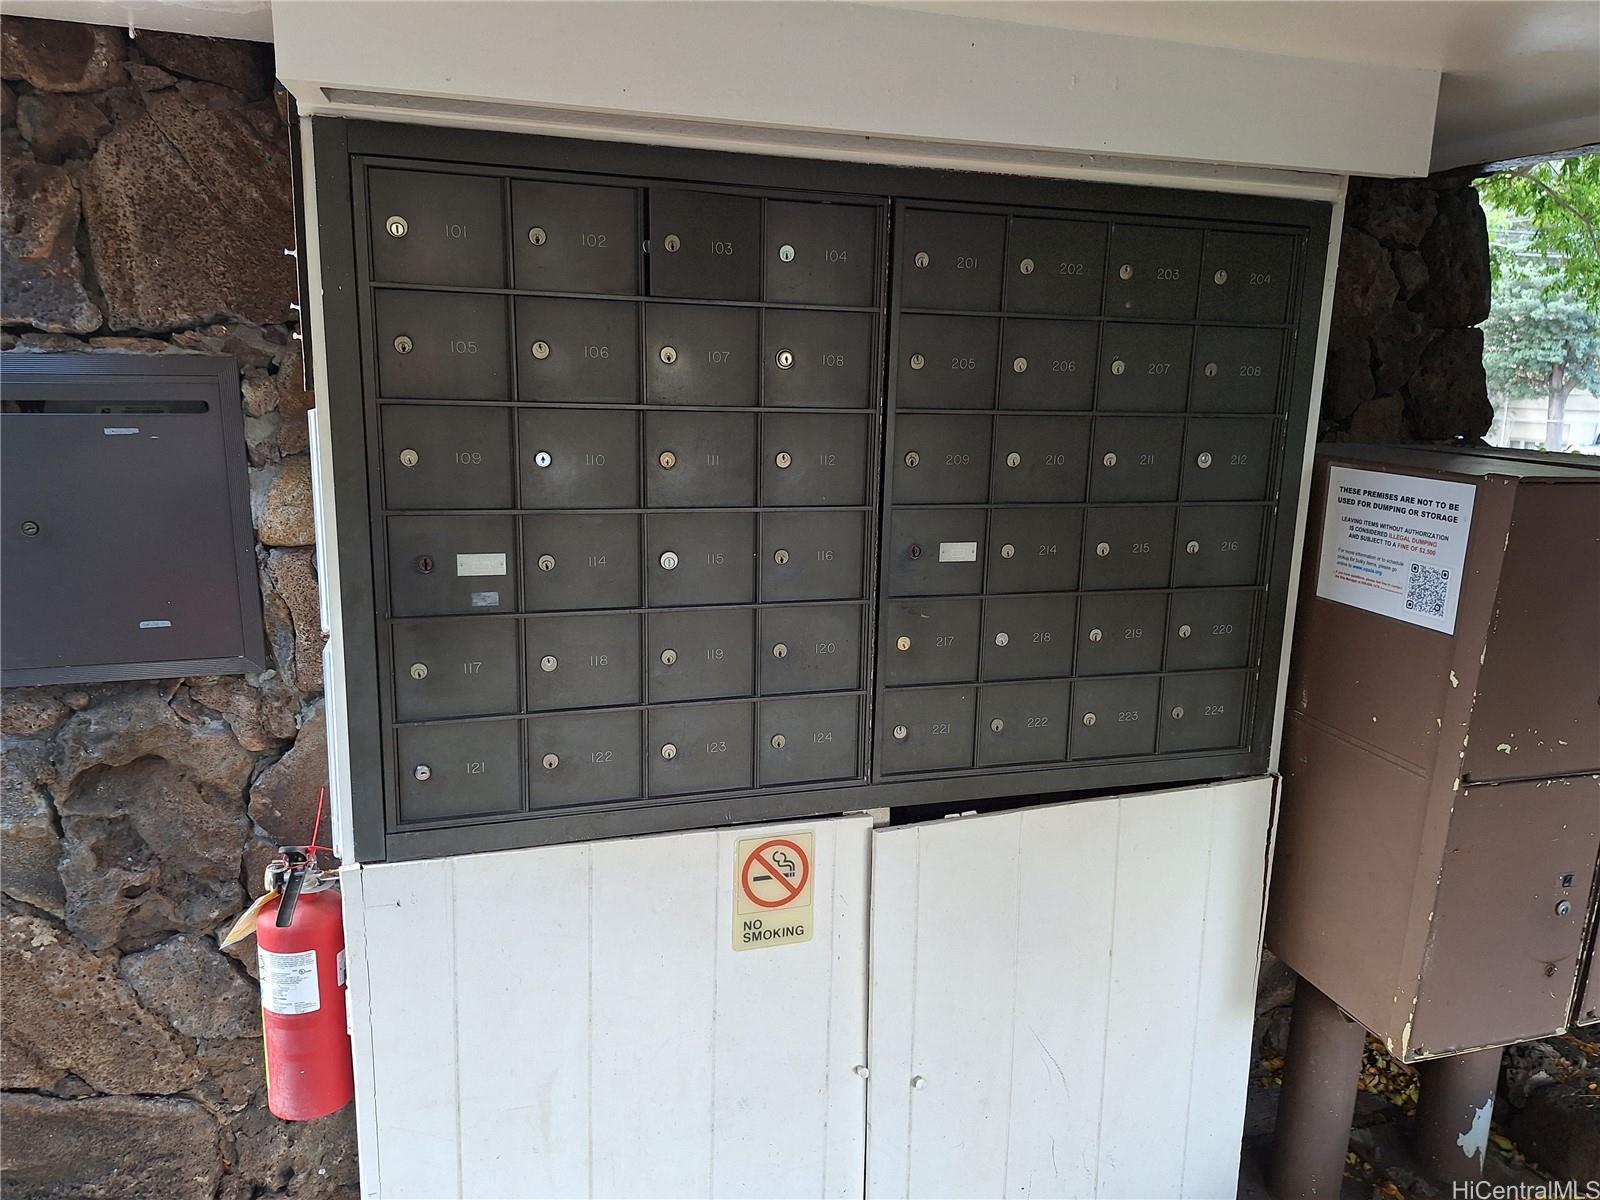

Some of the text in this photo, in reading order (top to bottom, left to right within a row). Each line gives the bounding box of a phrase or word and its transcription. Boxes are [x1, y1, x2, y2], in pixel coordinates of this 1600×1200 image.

[445, 224, 467, 239] 101
[581, 233, 607, 249] 102
[711, 242, 732, 256] 103
[824, 250, 848, 263] 104
[956, 257, 978, 269] 201
[1060, 264, 1083, 275] 202
[1157, 268, 1180, 280] 203
[1249, 273, 1271, 285] 204
[450, 341, 477, 355] 105
[583, 346, 609, 360] 106
[708, 352, 730, 364] 107
[822, 354, 844, 367] 108
[951, 358, 975, 370] 205
[1052, 360, 1076, 372] 206
[1148, 363, 1170, 375] 207
[1240, 365, 1262, 377] 208
[455, 452, 482, 466] 109
[585, 453, 605, 467] 110
[707, 454, 720, 466] 111
[820, 455, 836, 466] 112
[945, 455, 970, 466] 209
[1046, 454, 1065, 466] 210
[1140, 455, 1154, 465] 211
[1230, 455, 1247, 465] 212
[1340, 486, 1361, 495] THESE
[1363, 490, 1398, 501] PREMISES
[1400, 496, 1415, 504] ARE
[1417, 499, 1434, 507] NOT
[1449, 503, 1459, 511] BE
[1338, 497, 1355, 505] USED
[1373, 503, 1406, 514] DUMPING
[1421, 511, 1458, 523] STORAGE
[1341, 516, 1362, 525] LEAVING
[1380, 523, 1403, 532] WITHOUT
[1405, 528, 1449, 541] AUTHORIZATION
[1355, 527, 1388, 537] CONSIDERED
[1389, 534, 1410, 542] ILLEGAL
[1412, 538, 1437, 547] DUMPING
[1039, 545, 1057, 555] 214
[1132, 543, 1150, 554] 215
[1221, 541, 1237, 552] 216
[1360, 535, 1383, 545] SUBJECT
[1419, 547, 1436, 555] $2,500
[588, 555, 607, 568] 114
[707, 553, 724, 565] 115
[817, 550, 833, 562] 116
[1125, 628, 1143, 639] 219
[1212, 624, 1233, 635] 220
[936, 636, 954, 647] 217
[1033, 632, 1050, 643] 218
[707, 648, 724, 660] 119
[815, 642, 836, 654] 120
[590, 654, 608, 667] 118
[463, 662, 482, 675] 117
[1204, 704, 1224, 716] 224
[1027, 717, 1048, 728] 222
[1118, 711, 1138, 722] 223
[932, 723, 950, 735] 221
[813, 731, 832, 744] 124
[706, 741, 726, 754] 123
[591, 750, 613, 764] 122
[467, 761, 485, 775] 121
[744, 920, 762, 931] NO
[743, 925, 804, 943] SMOKING
